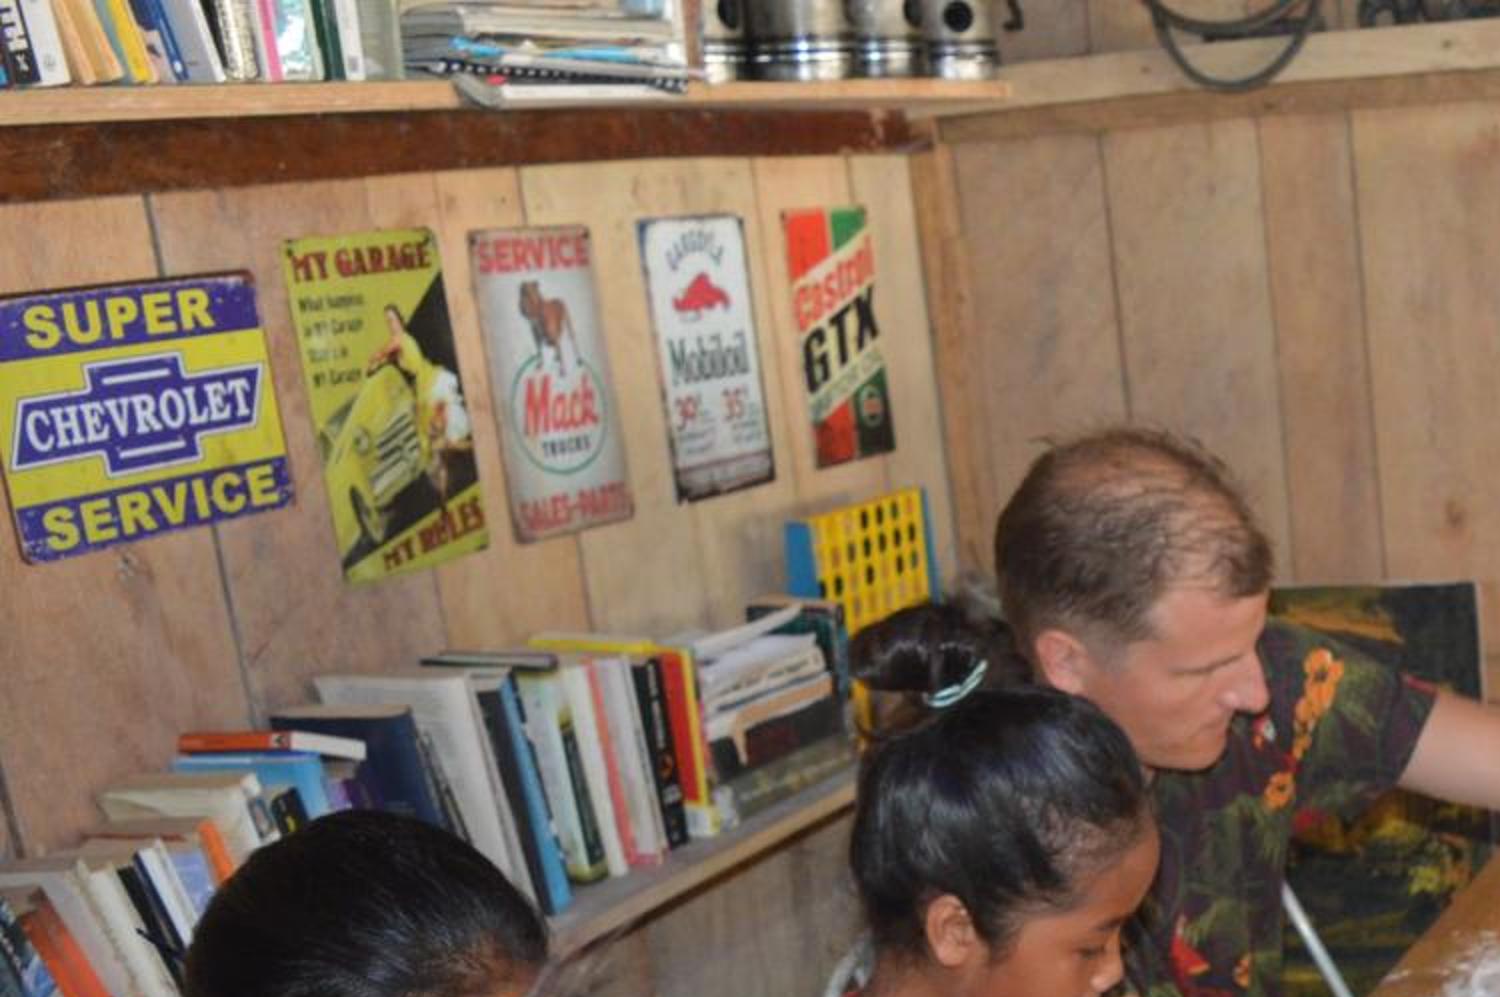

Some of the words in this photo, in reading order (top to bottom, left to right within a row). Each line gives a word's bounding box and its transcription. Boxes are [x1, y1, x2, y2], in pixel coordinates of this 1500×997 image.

[292, 252, 328, 283] MY
[336, 242, 430, 278] GARAGE
[479, 232, 590, 274] SERVICE
[793, 234, 875, 333] Castrol
[23, 288, 214, 349] SUPER
[803, 283, 879, 394] GTX
[26, 378, 250, 452] CHEVROLET
[523, 371, 598, 438] Mack
[43, 465, 279, 550] SERVICE
[383, 538, 415, 571] MY
[416, 496, 484, 554] RULES
